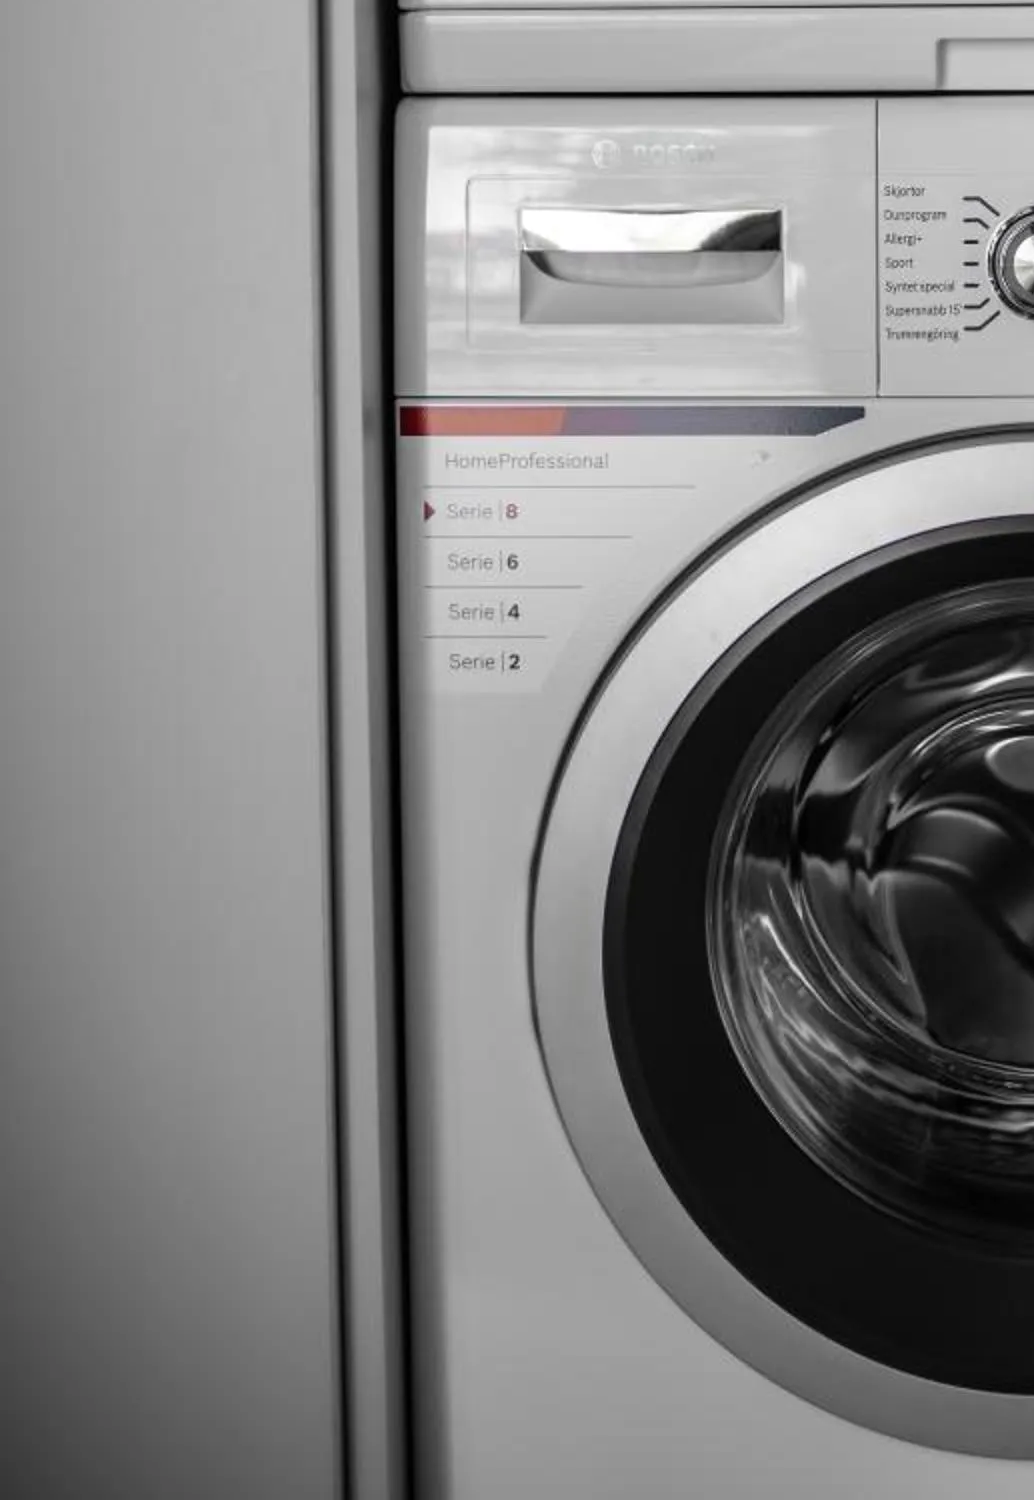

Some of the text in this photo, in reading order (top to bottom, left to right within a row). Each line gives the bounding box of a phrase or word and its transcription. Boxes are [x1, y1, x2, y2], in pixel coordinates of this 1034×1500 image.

[885, 257, 913, 270] Sport
[445, 452, 609, 470] HomeProfessional
[447, 503, 519, 520] Serie 8
[447, 553, 519, 570] Serie 6
[448, 603, 521, 621] Serie 4
[449, 653, 521, 671] Serie 2
